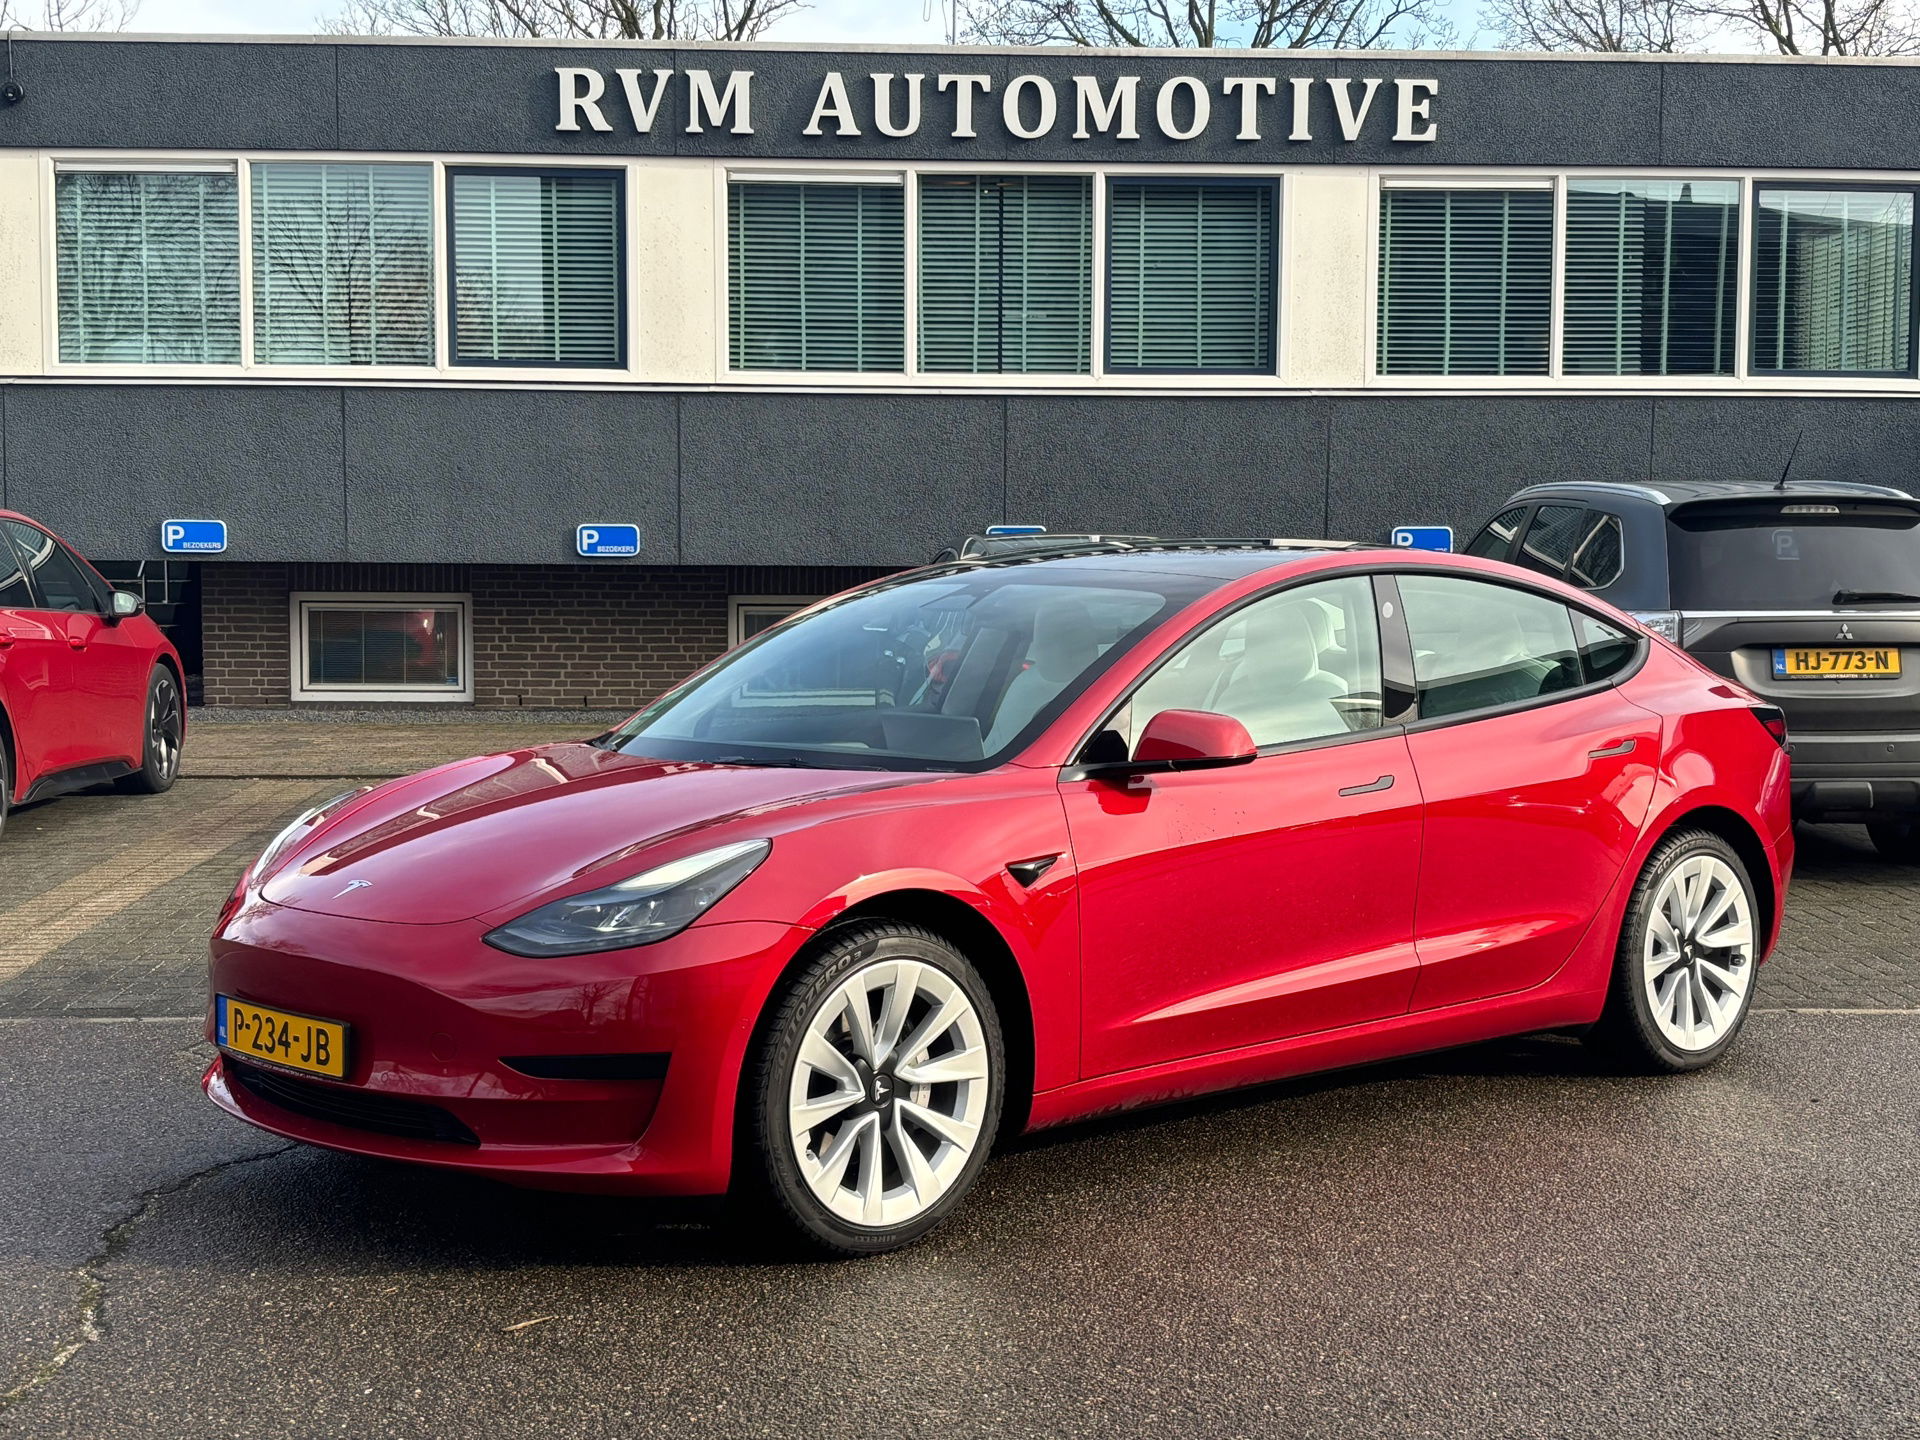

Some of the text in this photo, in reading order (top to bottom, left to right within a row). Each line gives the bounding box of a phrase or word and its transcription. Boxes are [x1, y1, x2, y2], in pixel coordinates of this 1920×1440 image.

[554, 67, 1439, 142] RVM AUTOMOTIVE
[167, 525, 185, 547] P
[582, 529, 599, 551] P
[1795, 651, 1889, 670] HJ-773-N
[234, 1008, 330, 1066] P-234-JB
[774, 954, 851, 1082] SOTTOZERO
